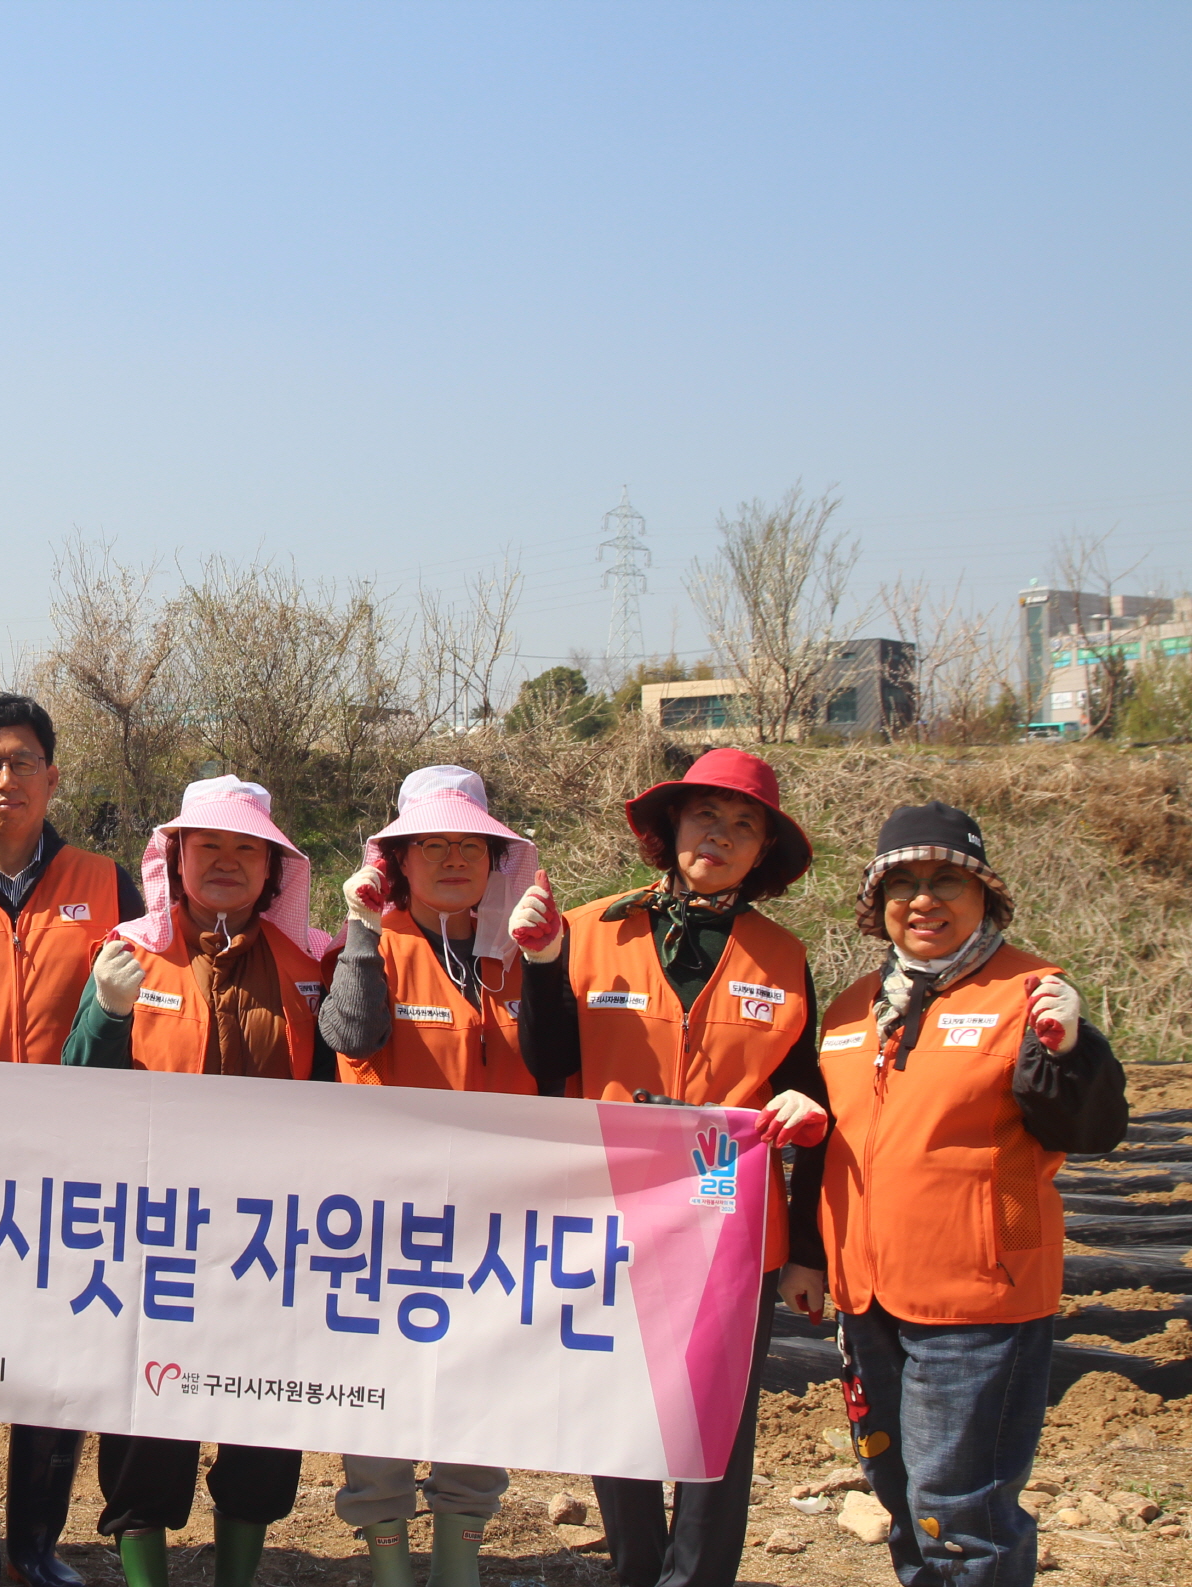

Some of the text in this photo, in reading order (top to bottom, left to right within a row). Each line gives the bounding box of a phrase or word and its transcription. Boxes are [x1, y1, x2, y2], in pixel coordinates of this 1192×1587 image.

[700, 1178, 736, 1197] 26
[230, 1193, 630, 1353] 자원봉사단
[181, 1372, 200, 1383] 사단
[181, 1383, 199, 1395] 법인
[203, 1373, 386, 1410] 구리시자원봉사센터
